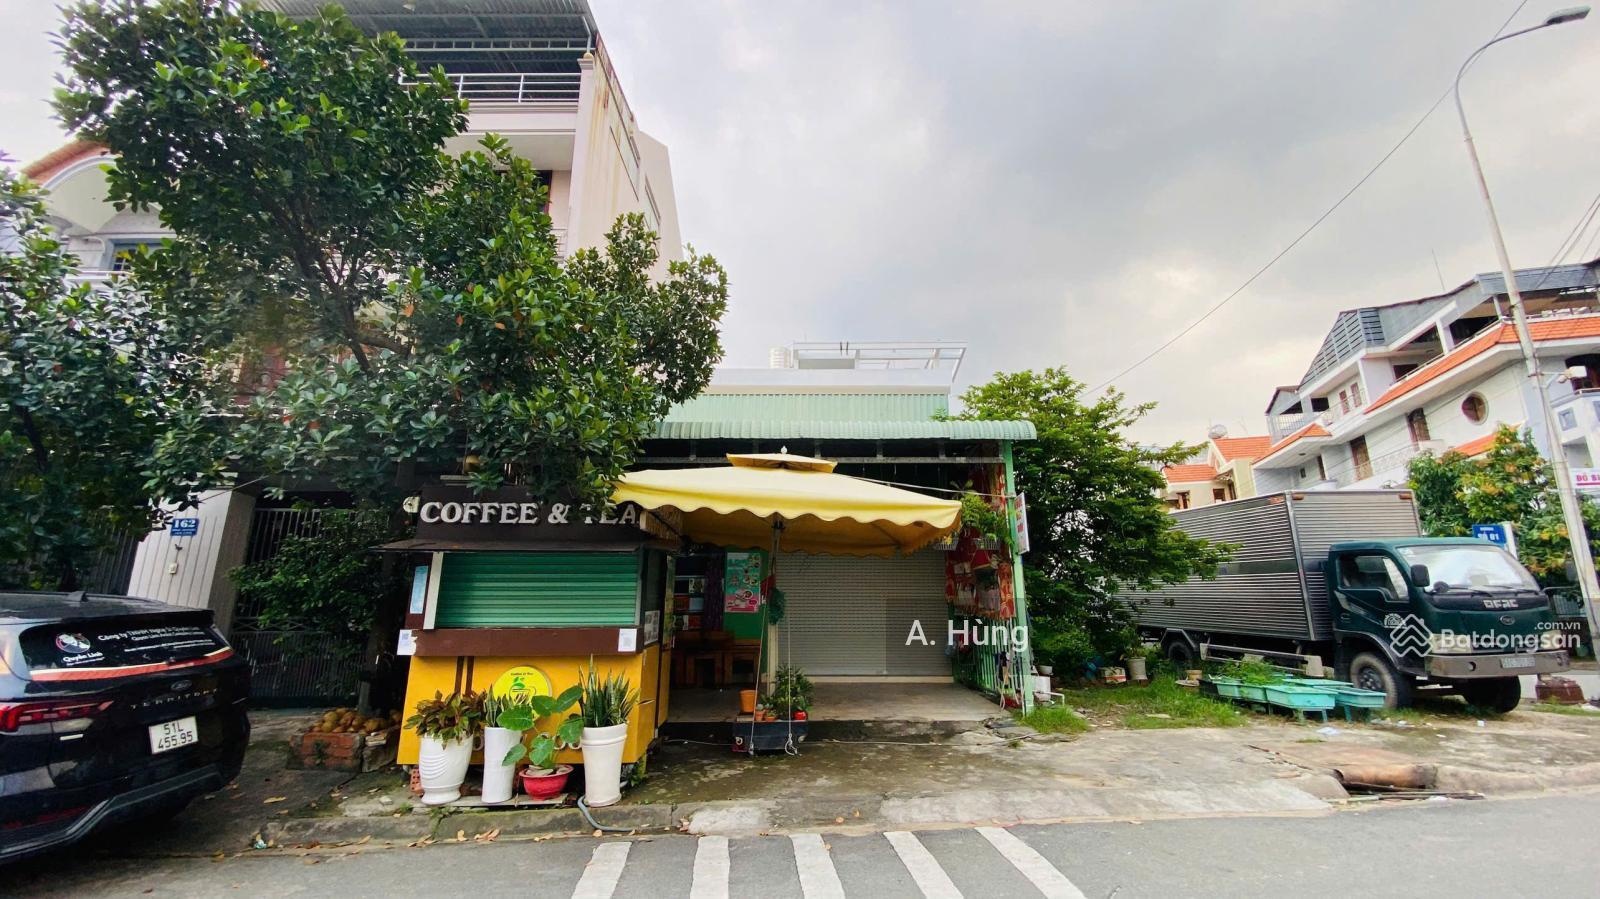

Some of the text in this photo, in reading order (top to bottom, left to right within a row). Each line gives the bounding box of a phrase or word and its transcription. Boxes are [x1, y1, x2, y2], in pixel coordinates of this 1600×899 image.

[420, 501, 539, 524] COFFEE
[547, 503, 572, 524] &
[174, 519, 197, 528] 162
[163, 721, 184, 736] 51L
[157, 731, 194, 750] 455.95
